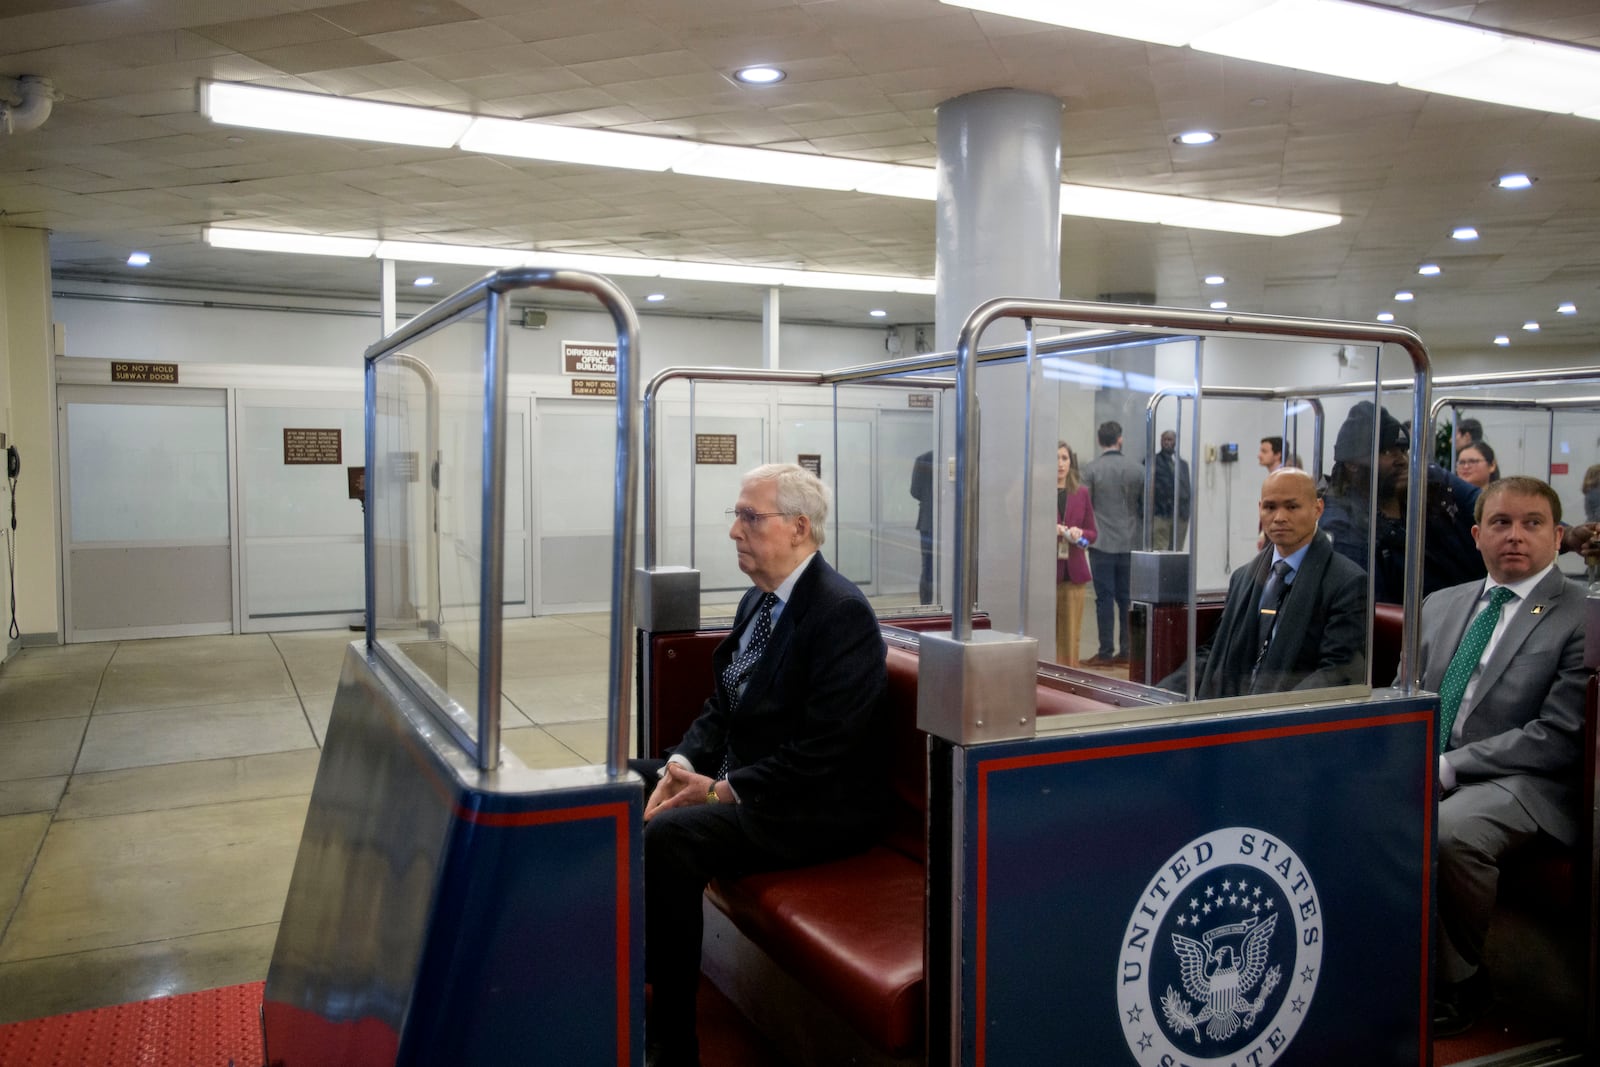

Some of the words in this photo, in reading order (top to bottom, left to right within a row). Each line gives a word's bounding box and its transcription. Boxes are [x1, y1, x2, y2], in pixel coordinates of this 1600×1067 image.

[581, 356, 608, 364] OFFICE
[576, 362, 616, 372] BUILDINGS
[116, 372, 146, 380] SUBWAY
[1123, 840, 1214, 986] UNITED
[1239, 833, 1319, 947] STATES
